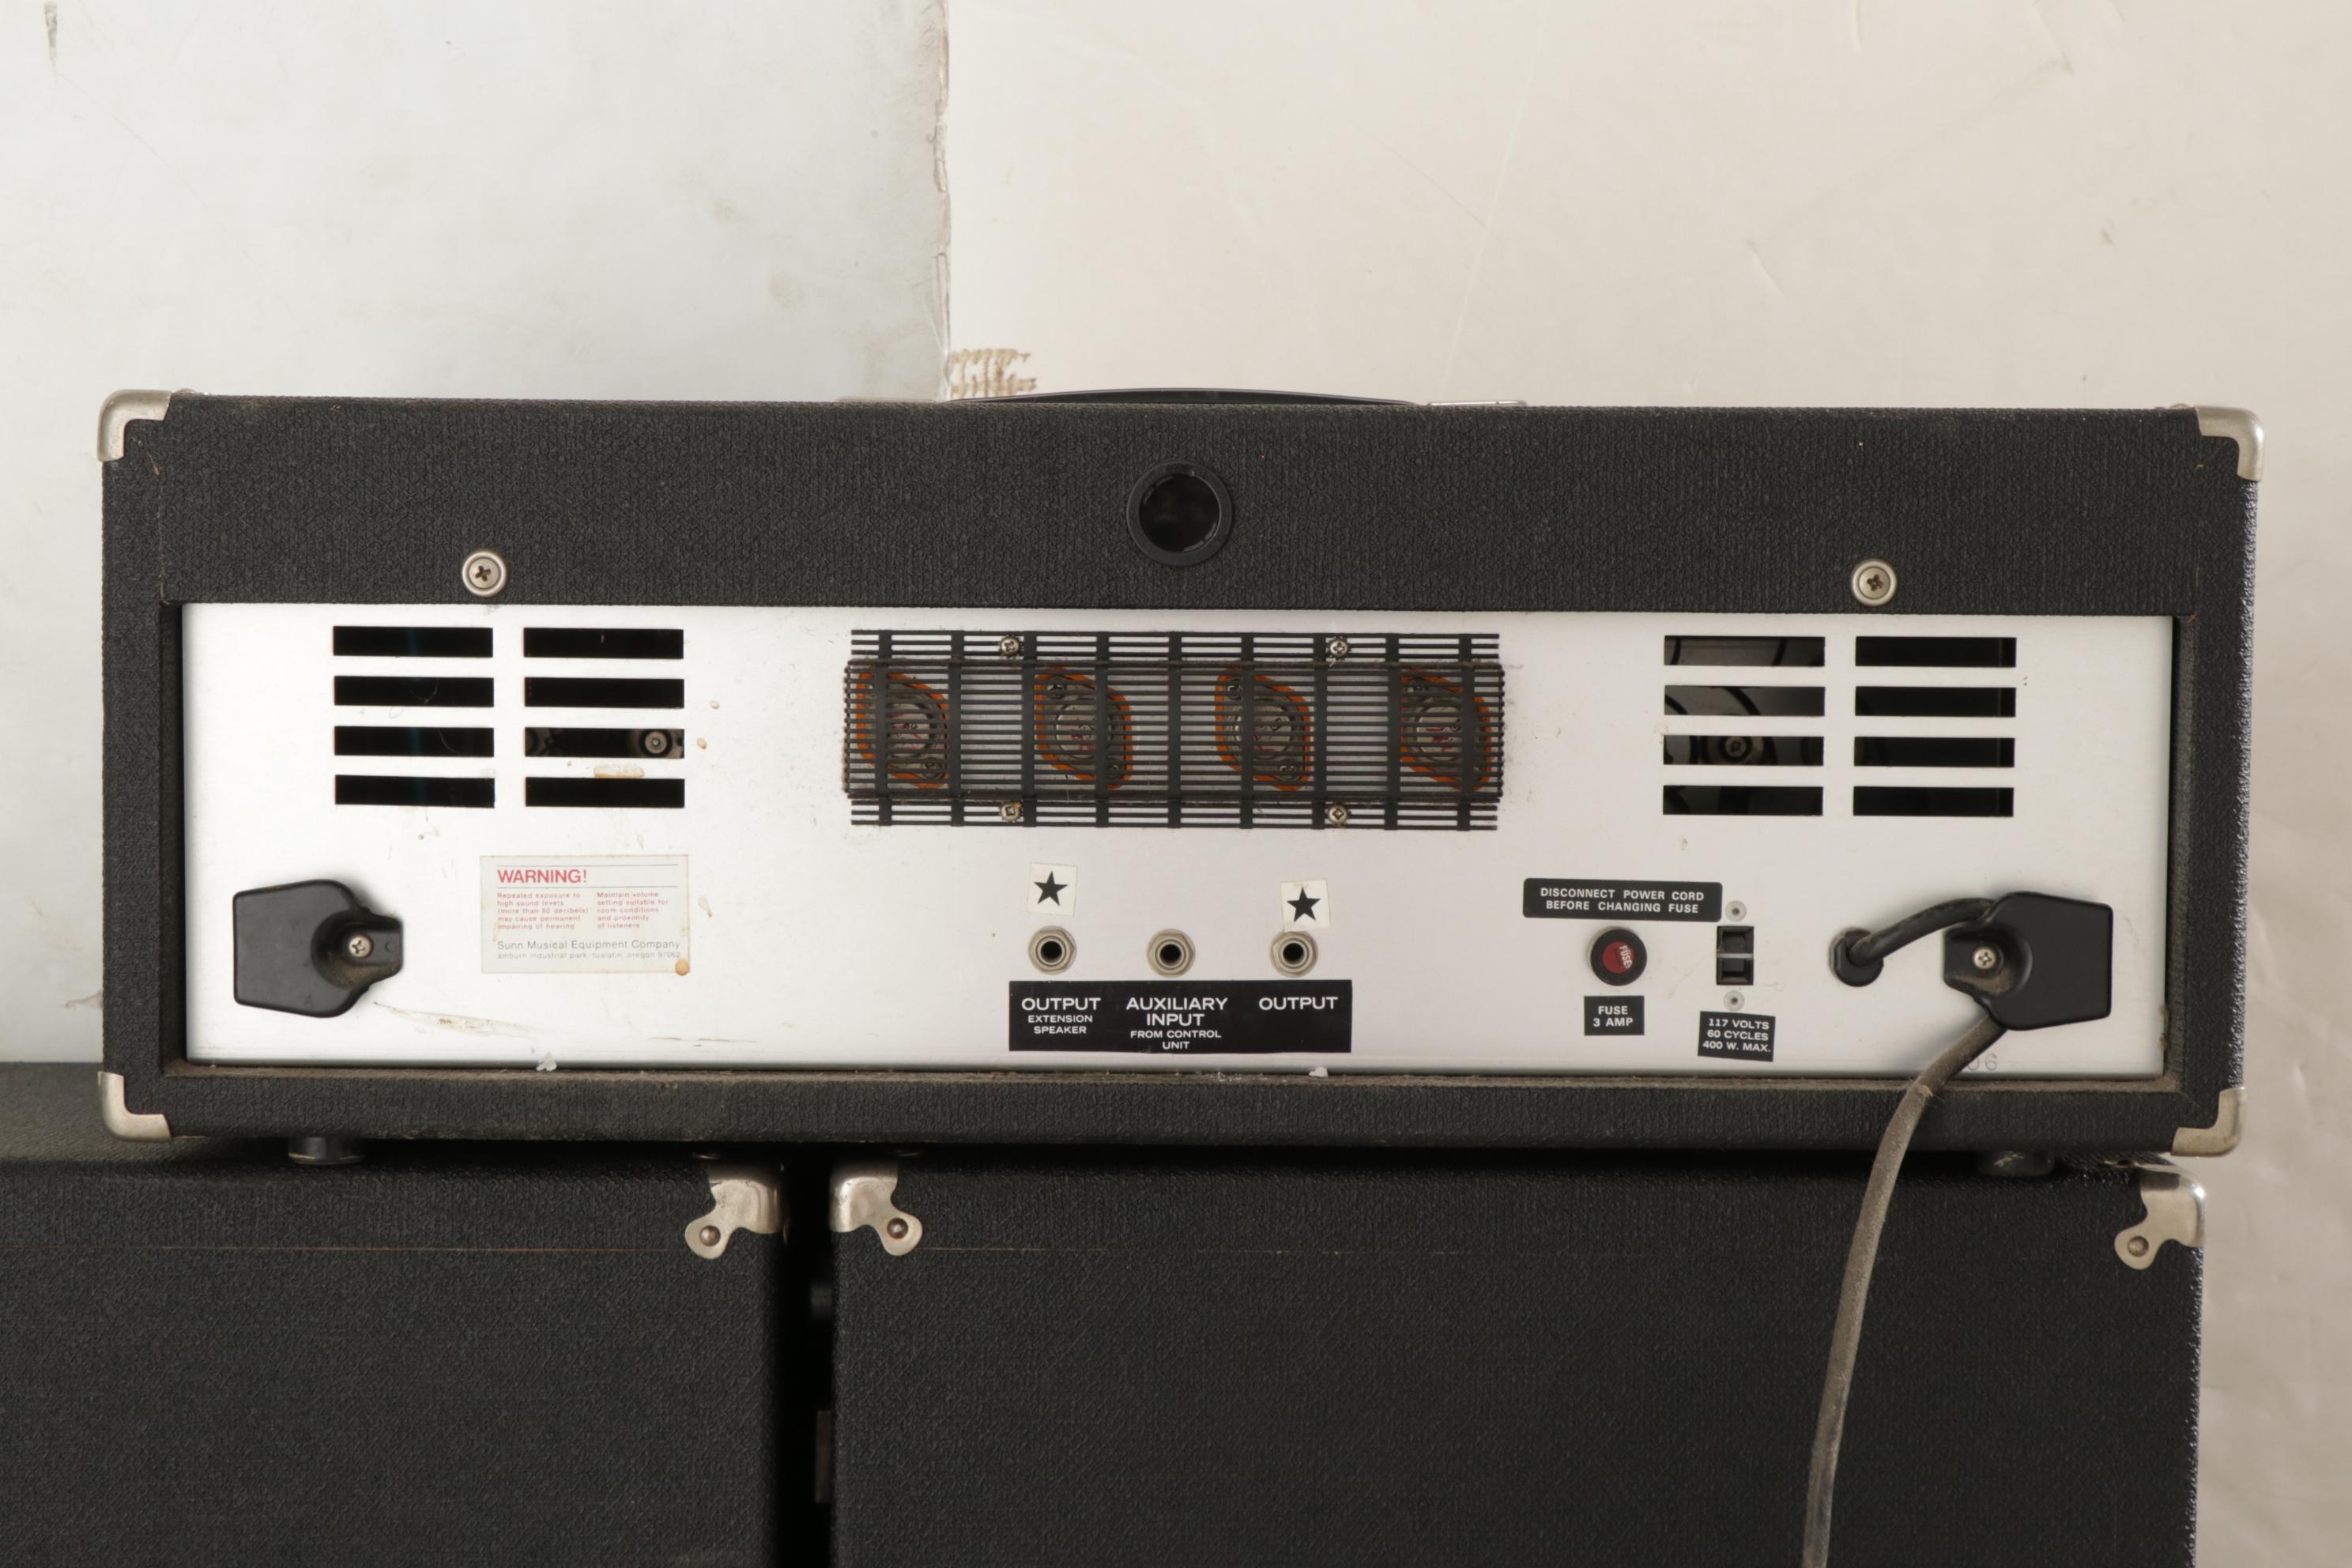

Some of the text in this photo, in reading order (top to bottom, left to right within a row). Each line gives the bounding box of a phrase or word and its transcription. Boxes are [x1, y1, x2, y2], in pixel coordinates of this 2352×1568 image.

[497, 869, 587, 884] WARNING!
[1540, 887, 1705, 901] DISCONNECT POWER CORD
[1546, 900, 1699, 914] BEFORE CHANGING FUSE
[497, 939, 680, 950] Sunn Musical Equipment Company
[1619, 944, 1633, 969] FUSE
[1021, 997, 1102, 1011] OUTPUT
[1125, 997, 1229, 1011] AUXILIARY
[1258, 996, 1339, 1011] OUTPUT
[1598, 1005, 1628, 1016] FUSE
[1027, 1014, 1093, 1023] EXTENSION
[1146, 1013, 1205, 1027] INPUT
[1592, 1016, 1634, 1027] 3 AMP
[1709, 1018, 1770, 1030] 117 VOLTS
[1034, 1026, 1087, 1035] SPEAKER
[1130, 1030, 1222, 1038] FROM CONTROL
[1707, 1029, 1769, 1041] 60 CYCLES
[1162, 1041, 1190, 1050] UNIT
[1702, 1040, 1771, 1053] 400 W. MAX.
